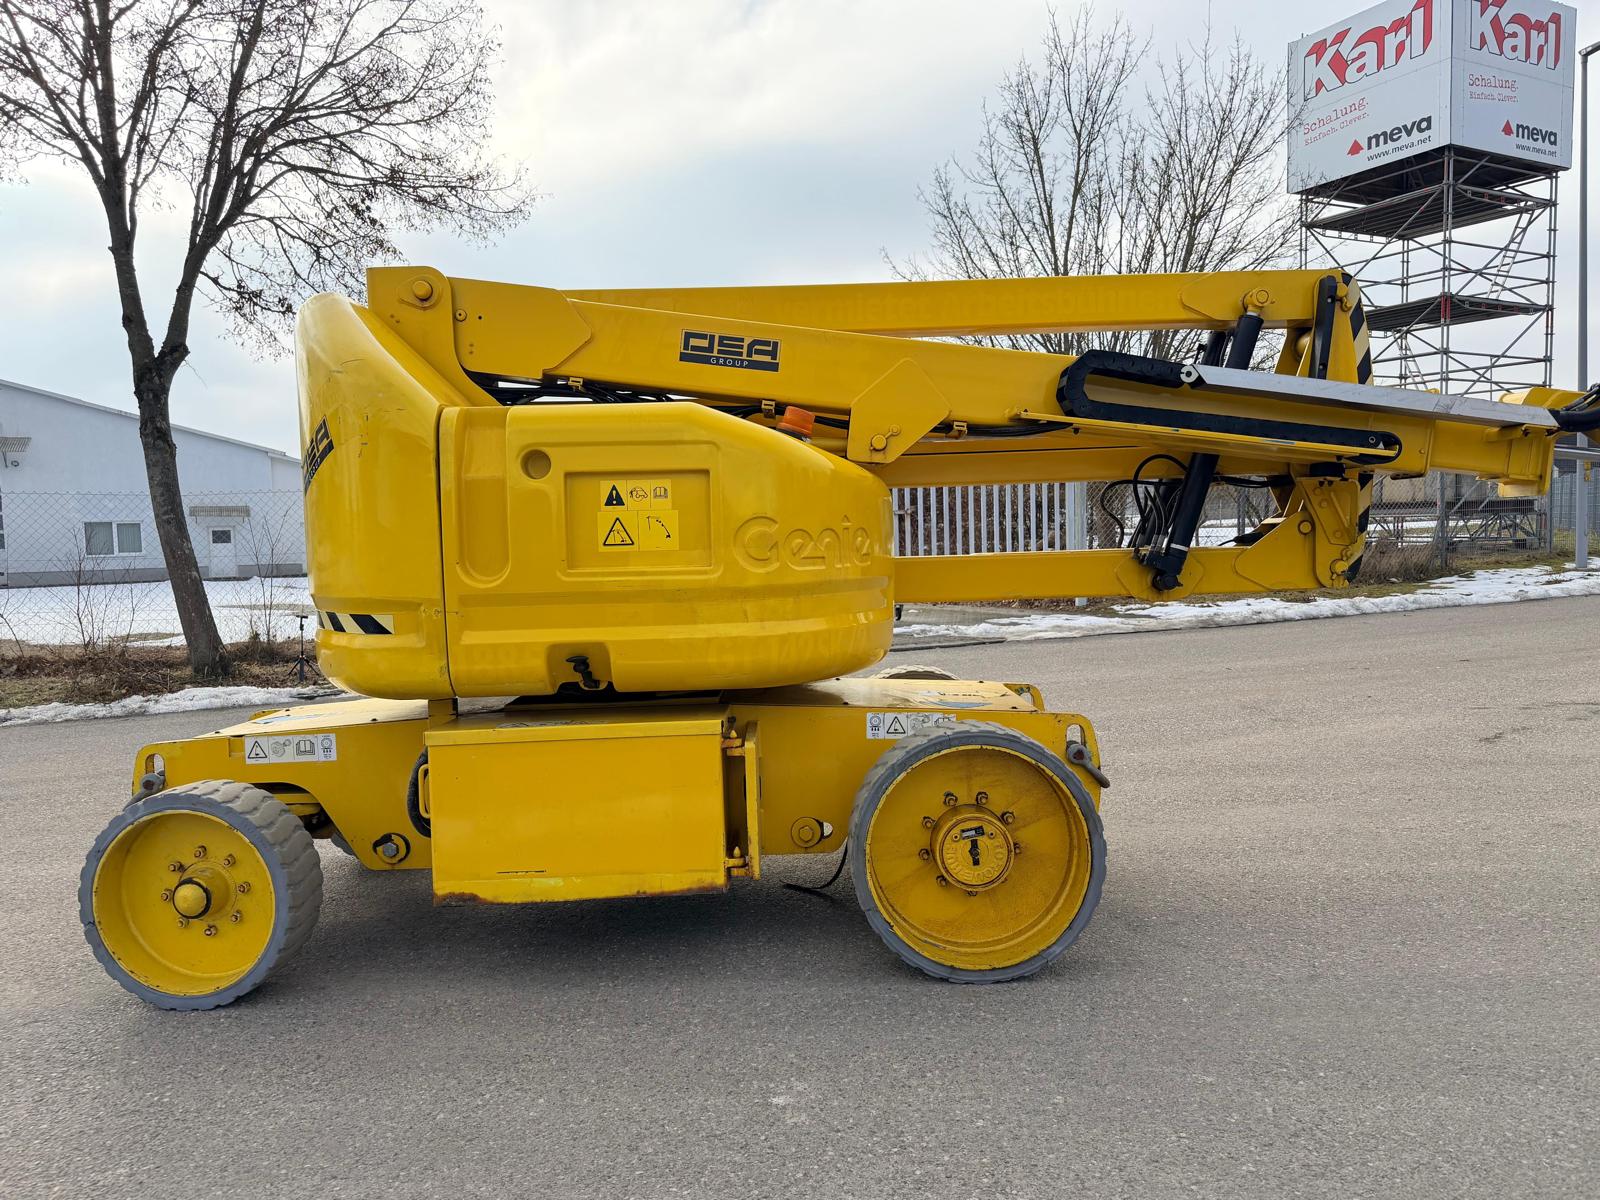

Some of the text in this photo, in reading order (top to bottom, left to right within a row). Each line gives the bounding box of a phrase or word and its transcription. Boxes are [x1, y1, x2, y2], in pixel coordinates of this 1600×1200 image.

[1304, 0, 1433, 101] Karl
[1470, 0, 1561, 70] Karl
[1469, 74, 1519, 92] Schalung.
[1303, 97, 1369, 135] Schalung.
[1367, 115, 1432, 150] meva
[1516, 123, 1558, 146] meva
[1366, 135, 1432, 162] www.meva.net
[1515, 143, 1557, 158] www.meva.net
[710, 357, 749, 367] GROUP
[733, 514, 872, 573] Genie
